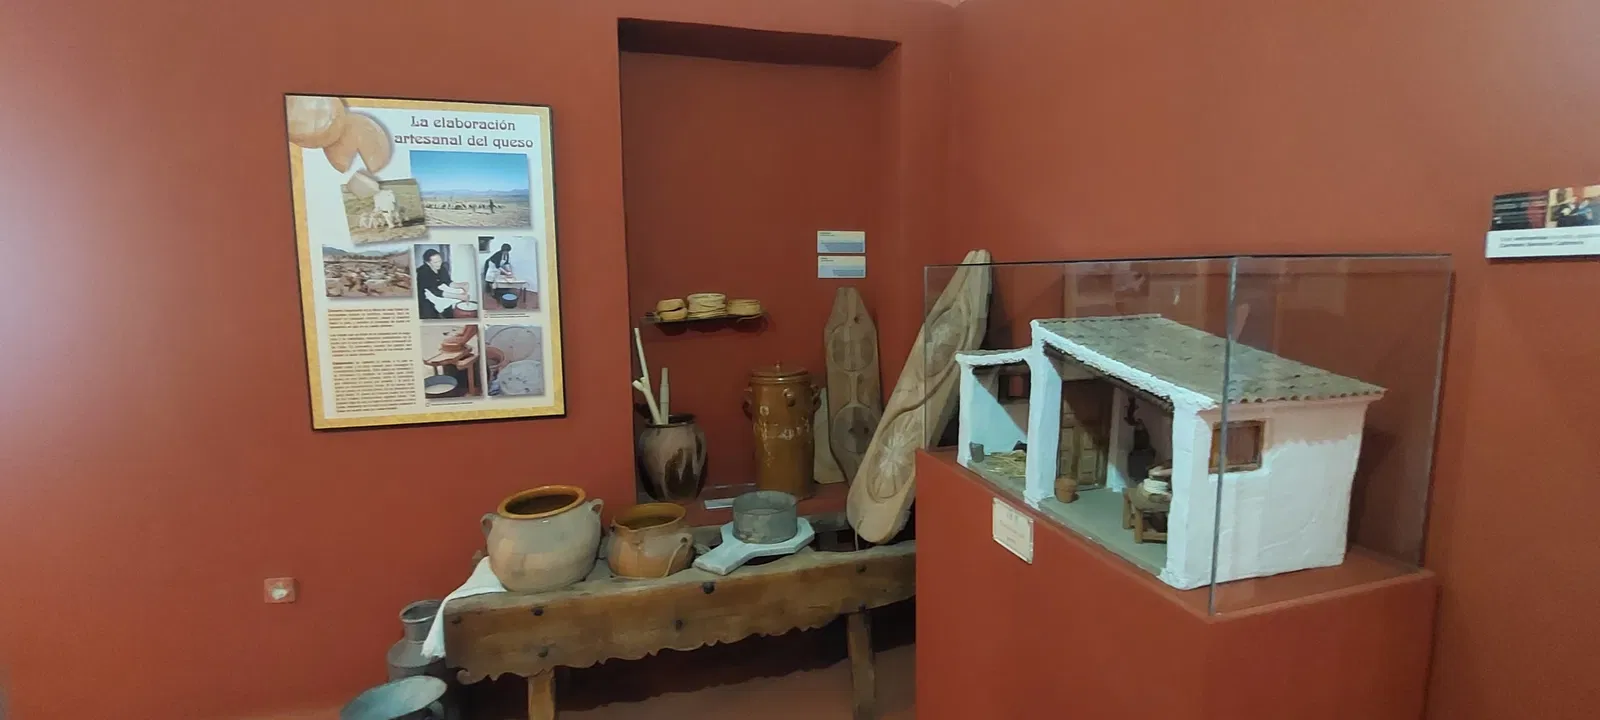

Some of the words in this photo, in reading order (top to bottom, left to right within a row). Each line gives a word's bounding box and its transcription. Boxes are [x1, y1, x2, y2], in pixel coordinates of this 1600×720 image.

[410, 116, 428, 127] La
[433, 117, 516, 131] elaboración
[394, 134, 462, 146] artesanal
[467, 135, 488, 147] del
[492, 137, 534, 149] queso
